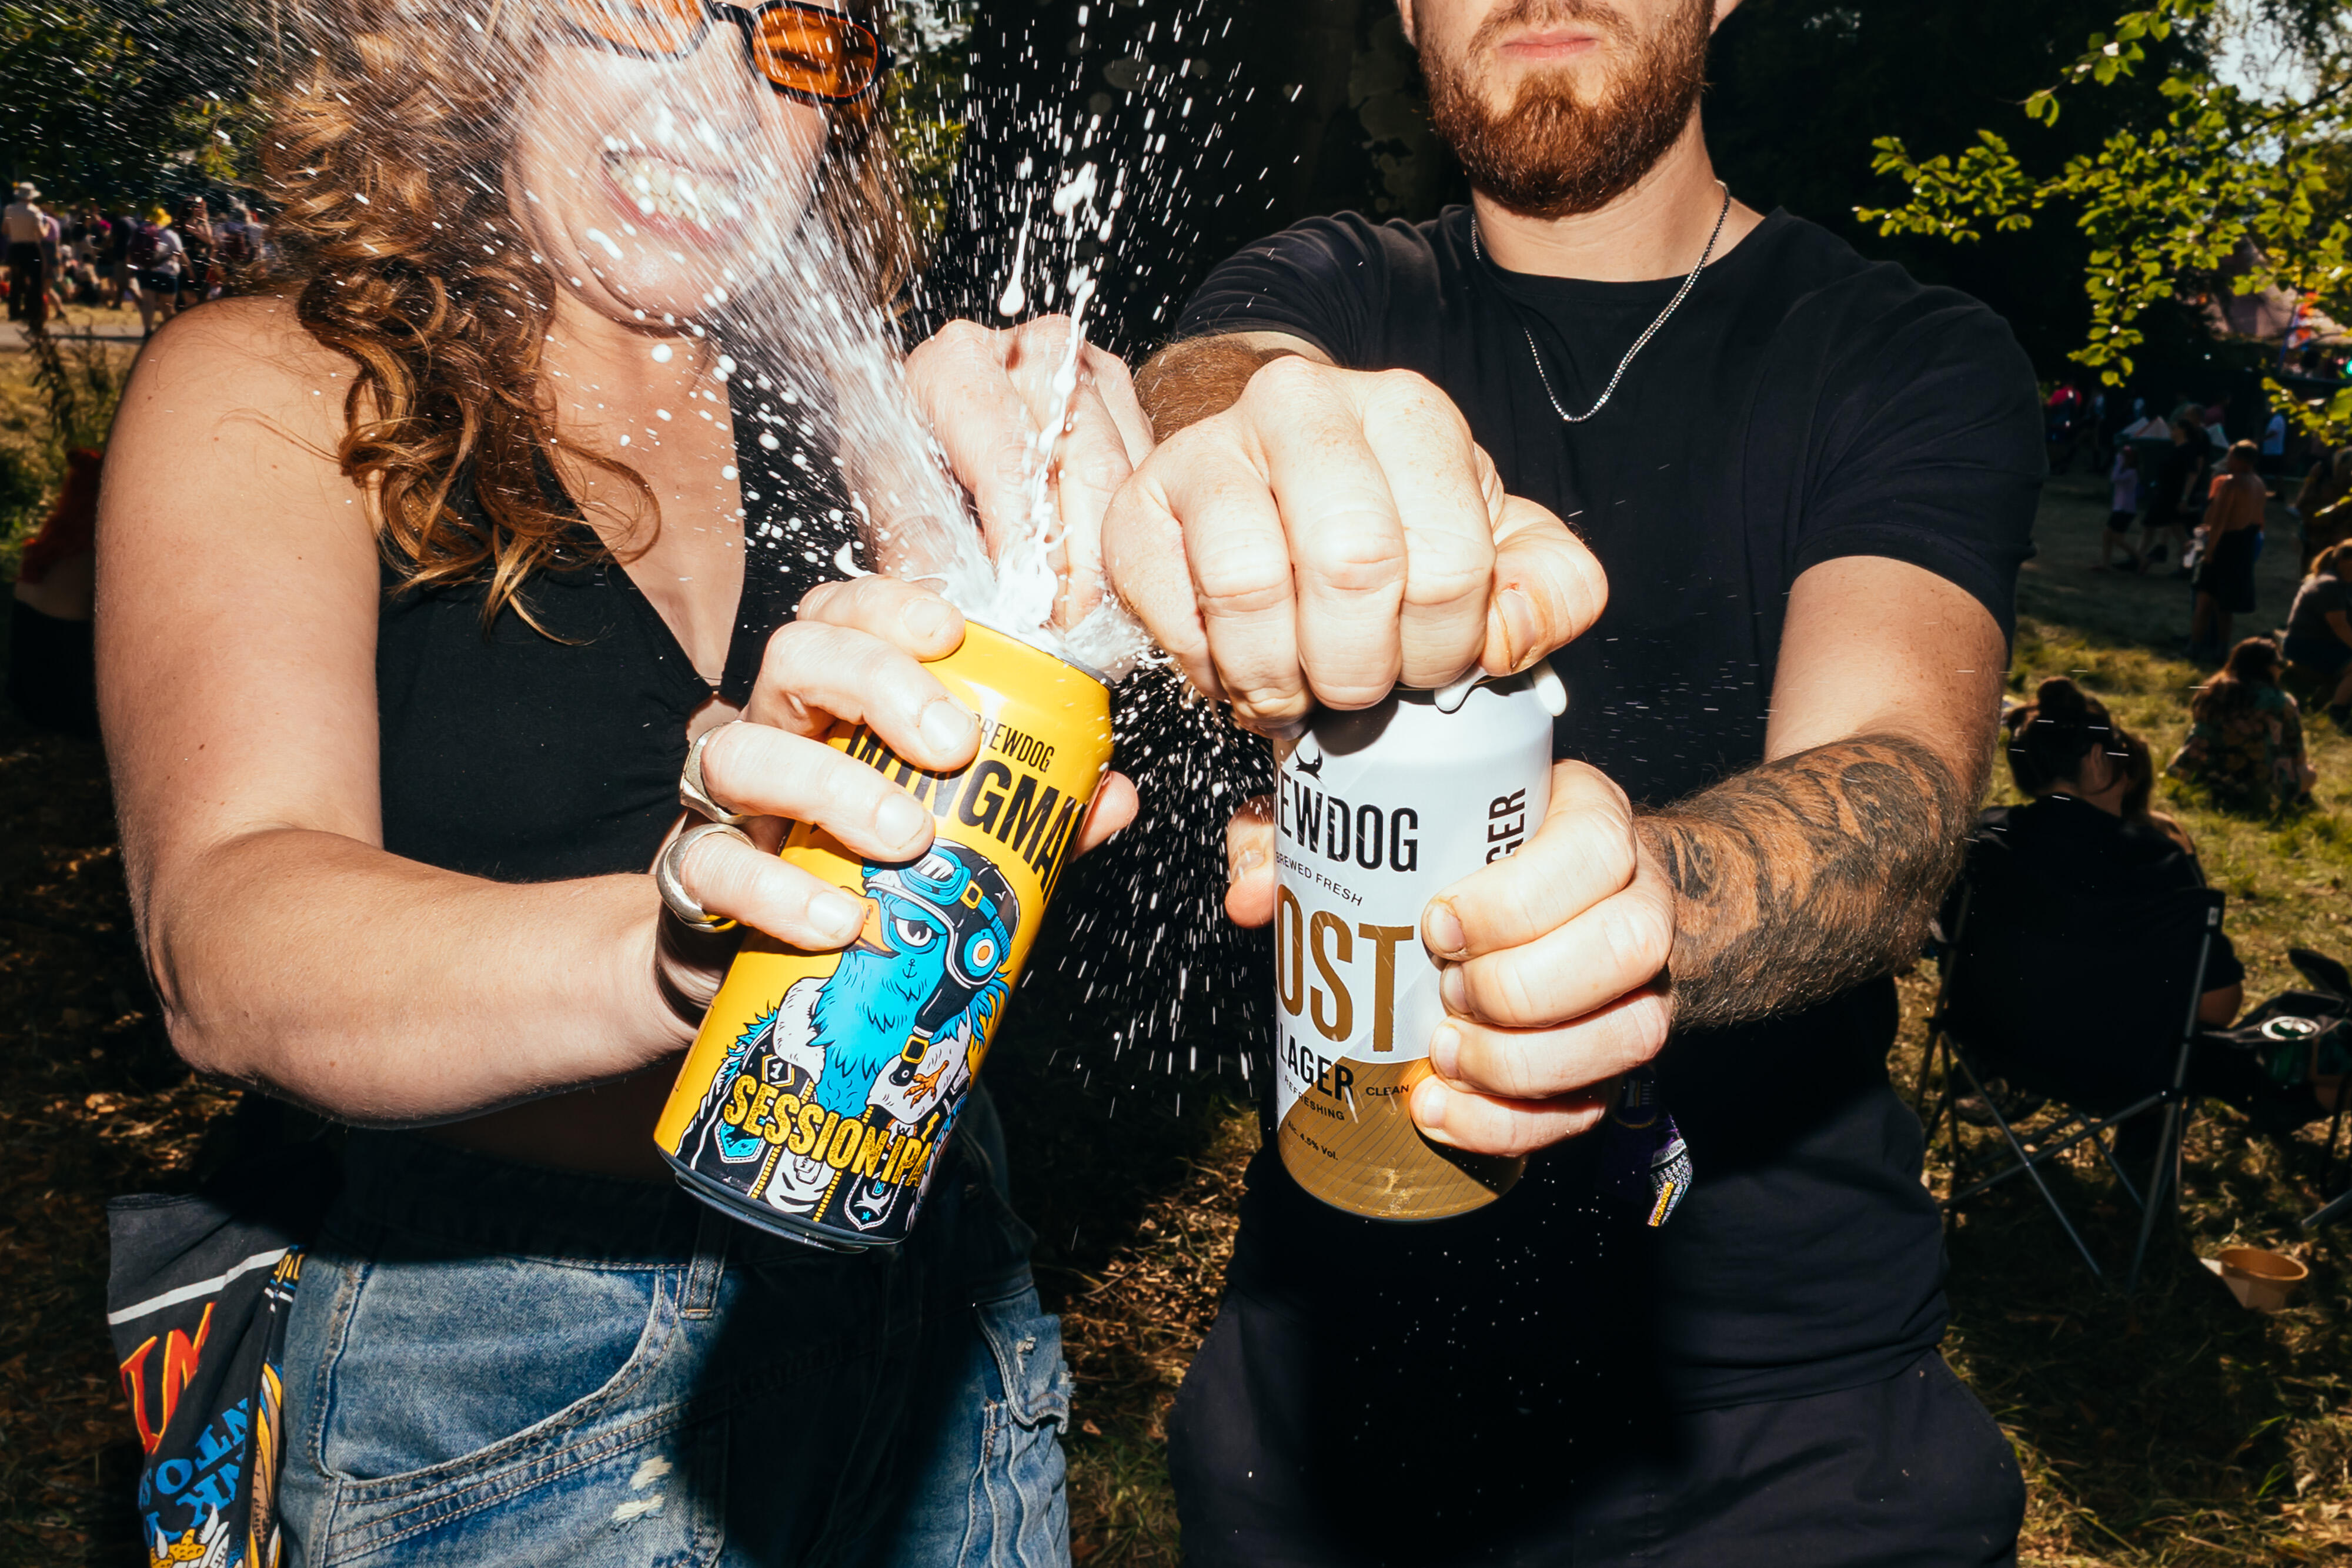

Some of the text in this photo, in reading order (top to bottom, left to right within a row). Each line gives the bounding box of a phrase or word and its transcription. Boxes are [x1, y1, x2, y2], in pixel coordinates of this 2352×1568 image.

[1275, 767, 1418, 872] EWDOG
[1275, 851, 1363, 907] BREWED FRESH
[1279, 1022, 1354, 1104] LAGER
[1365, 1084, 1409, 1097] CLEAN
[1284, 1074, 1345, 1121] REFRESHING
[724, 1075, 933, 1187] SESSION IPA
[1299, 1134, 1319, 1152] 4.5%
[1321, 1145, 1339, 1161] Vol.
